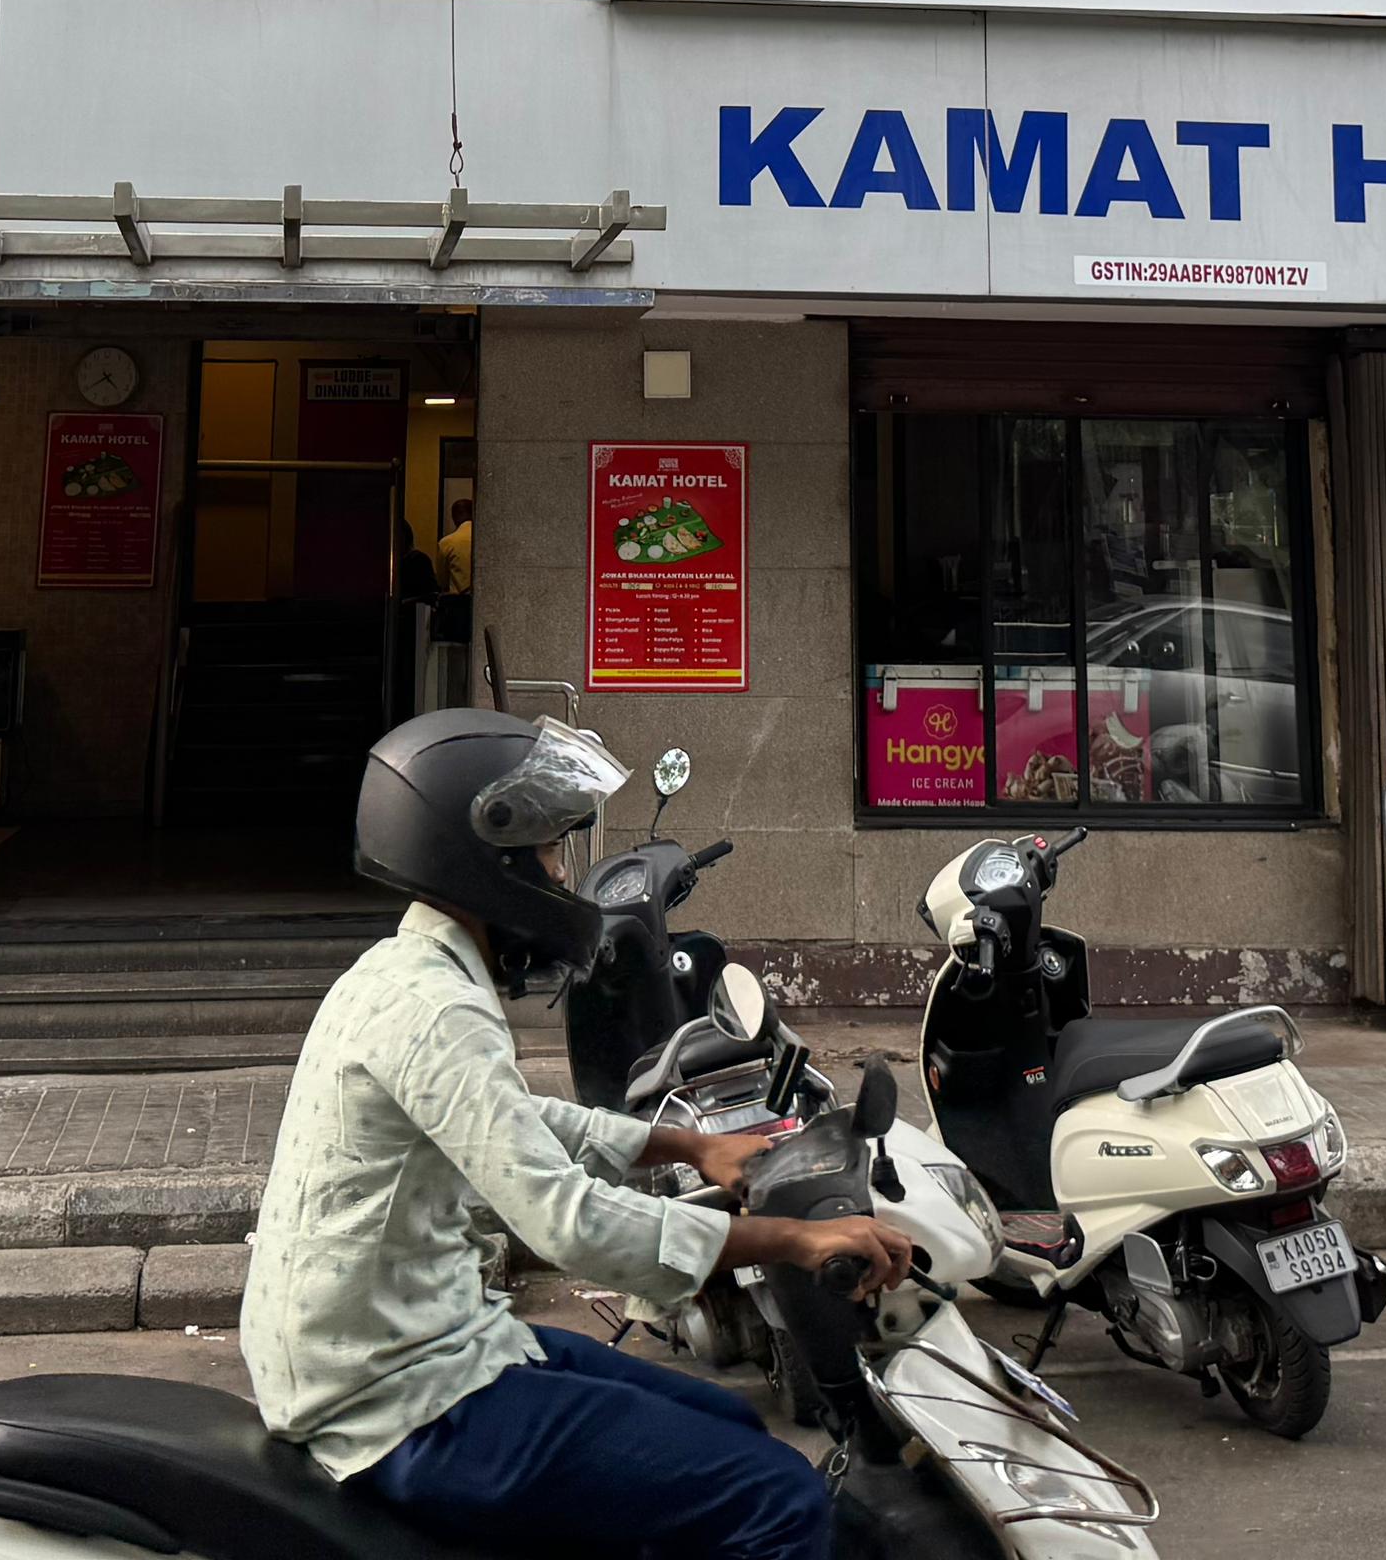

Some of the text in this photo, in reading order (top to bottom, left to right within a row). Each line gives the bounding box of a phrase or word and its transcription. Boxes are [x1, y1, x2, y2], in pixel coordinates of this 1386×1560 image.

[719, 106, 1270, 221] KAMAT
[1091, 261, 1308, 286] GSTIN:29AABFK9870N1ZV
[315, 384, 391, 397] DINING HALL
[61, 434, 149, 445] KAMAT HOTEL
[609, 474, 728, 488] KAMAT HOTEL
[912, 778, 974, 789] ICE CREAM
[877, 797, 901, 807] Made
[938, 797, 961, 807] Made
[1289, 1250, 1346, 1283] S9394
